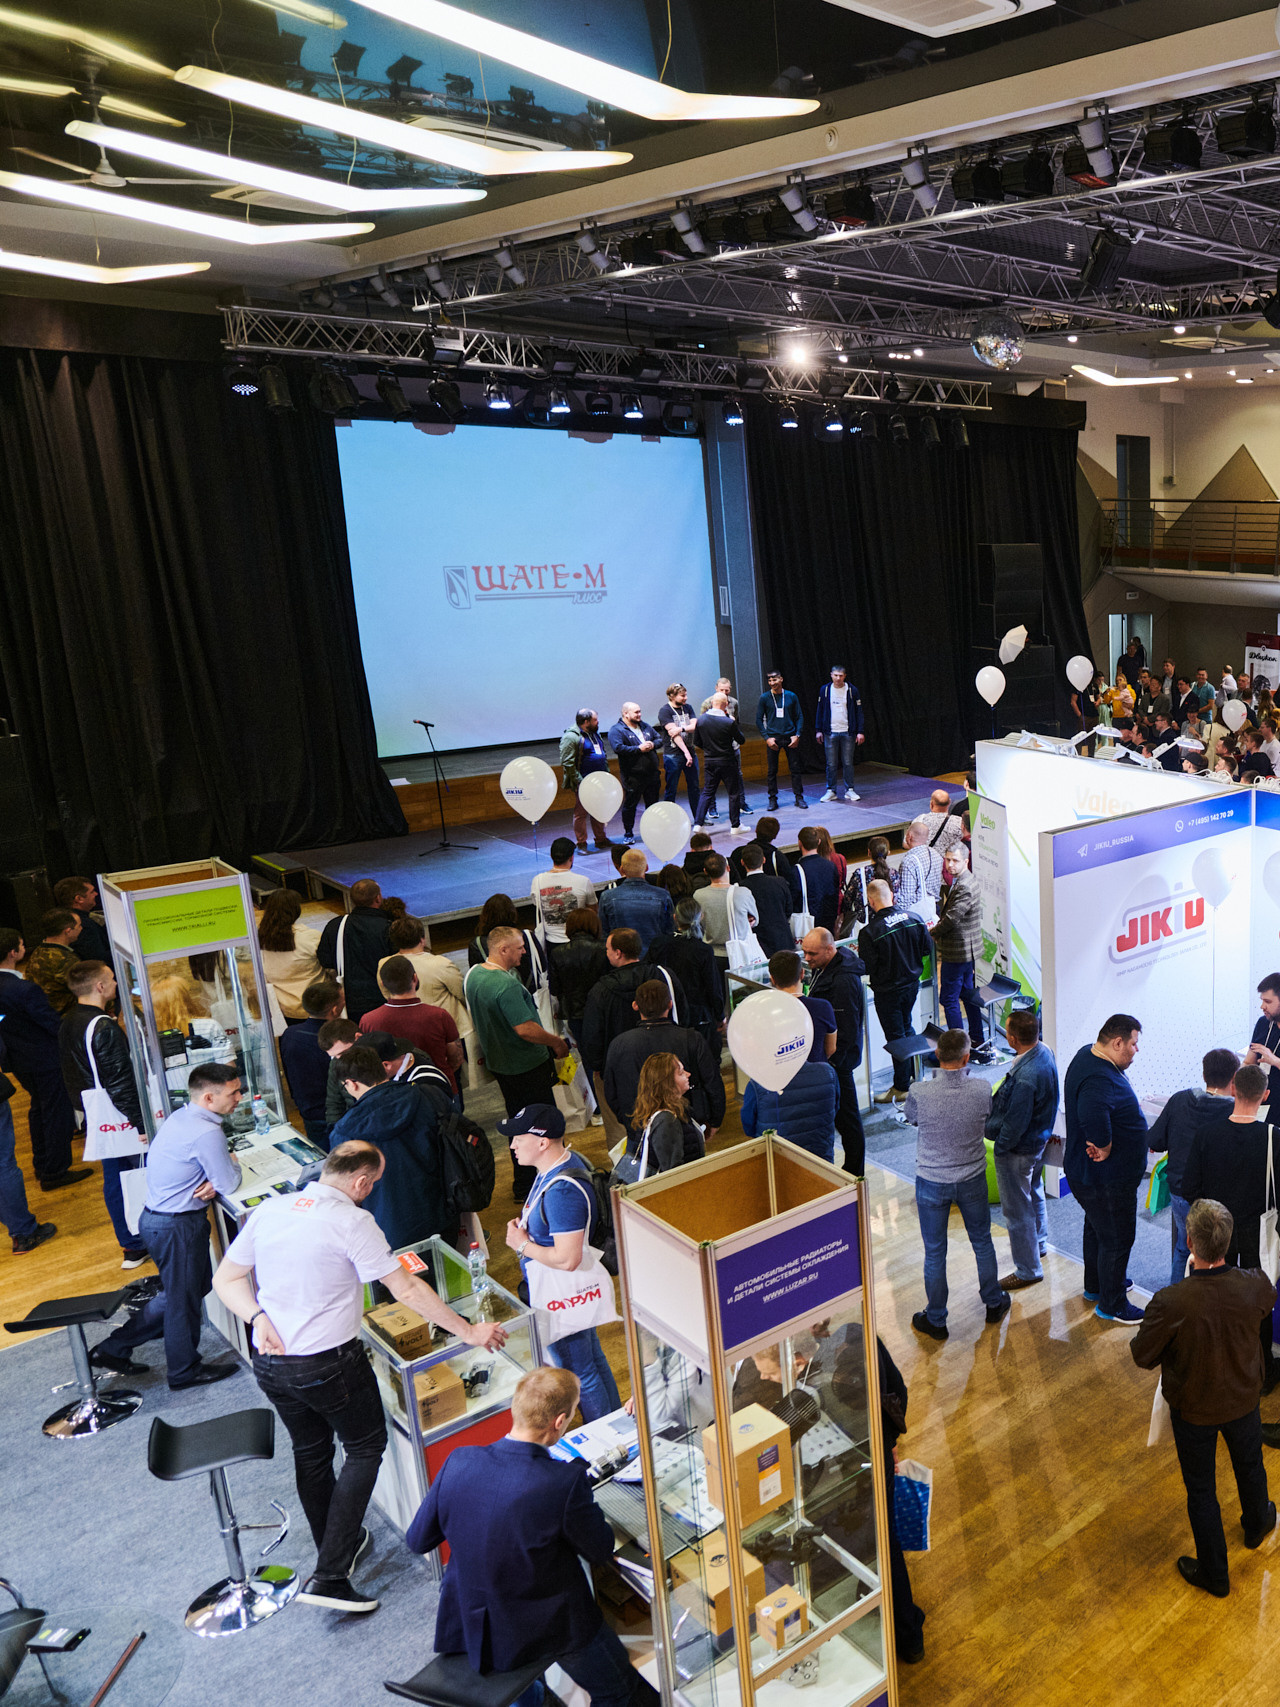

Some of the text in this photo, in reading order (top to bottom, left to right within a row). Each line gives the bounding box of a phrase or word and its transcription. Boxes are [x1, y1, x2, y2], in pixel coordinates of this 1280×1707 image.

[1210, 812, 1220, 823] 142
[1220, 811, 1227, 820] 70
[1116, 884, 1205, 953] JIKIU
[777, 1037, 805, 1055] JIKIU
[727, 1243, 850, 1305] И ДЕТАЛИ СИСТЕМЫ ОХЛАЖДЕНИЯ
[733, 1238, 843, 1294] АВТОМОБИЛЬНЫЕ РАДИАТОРЫ
[547, 1287, 602, 1312] ФОРУМ
[762, 1271, 819, 1304] WWW.LUZAR.RU
